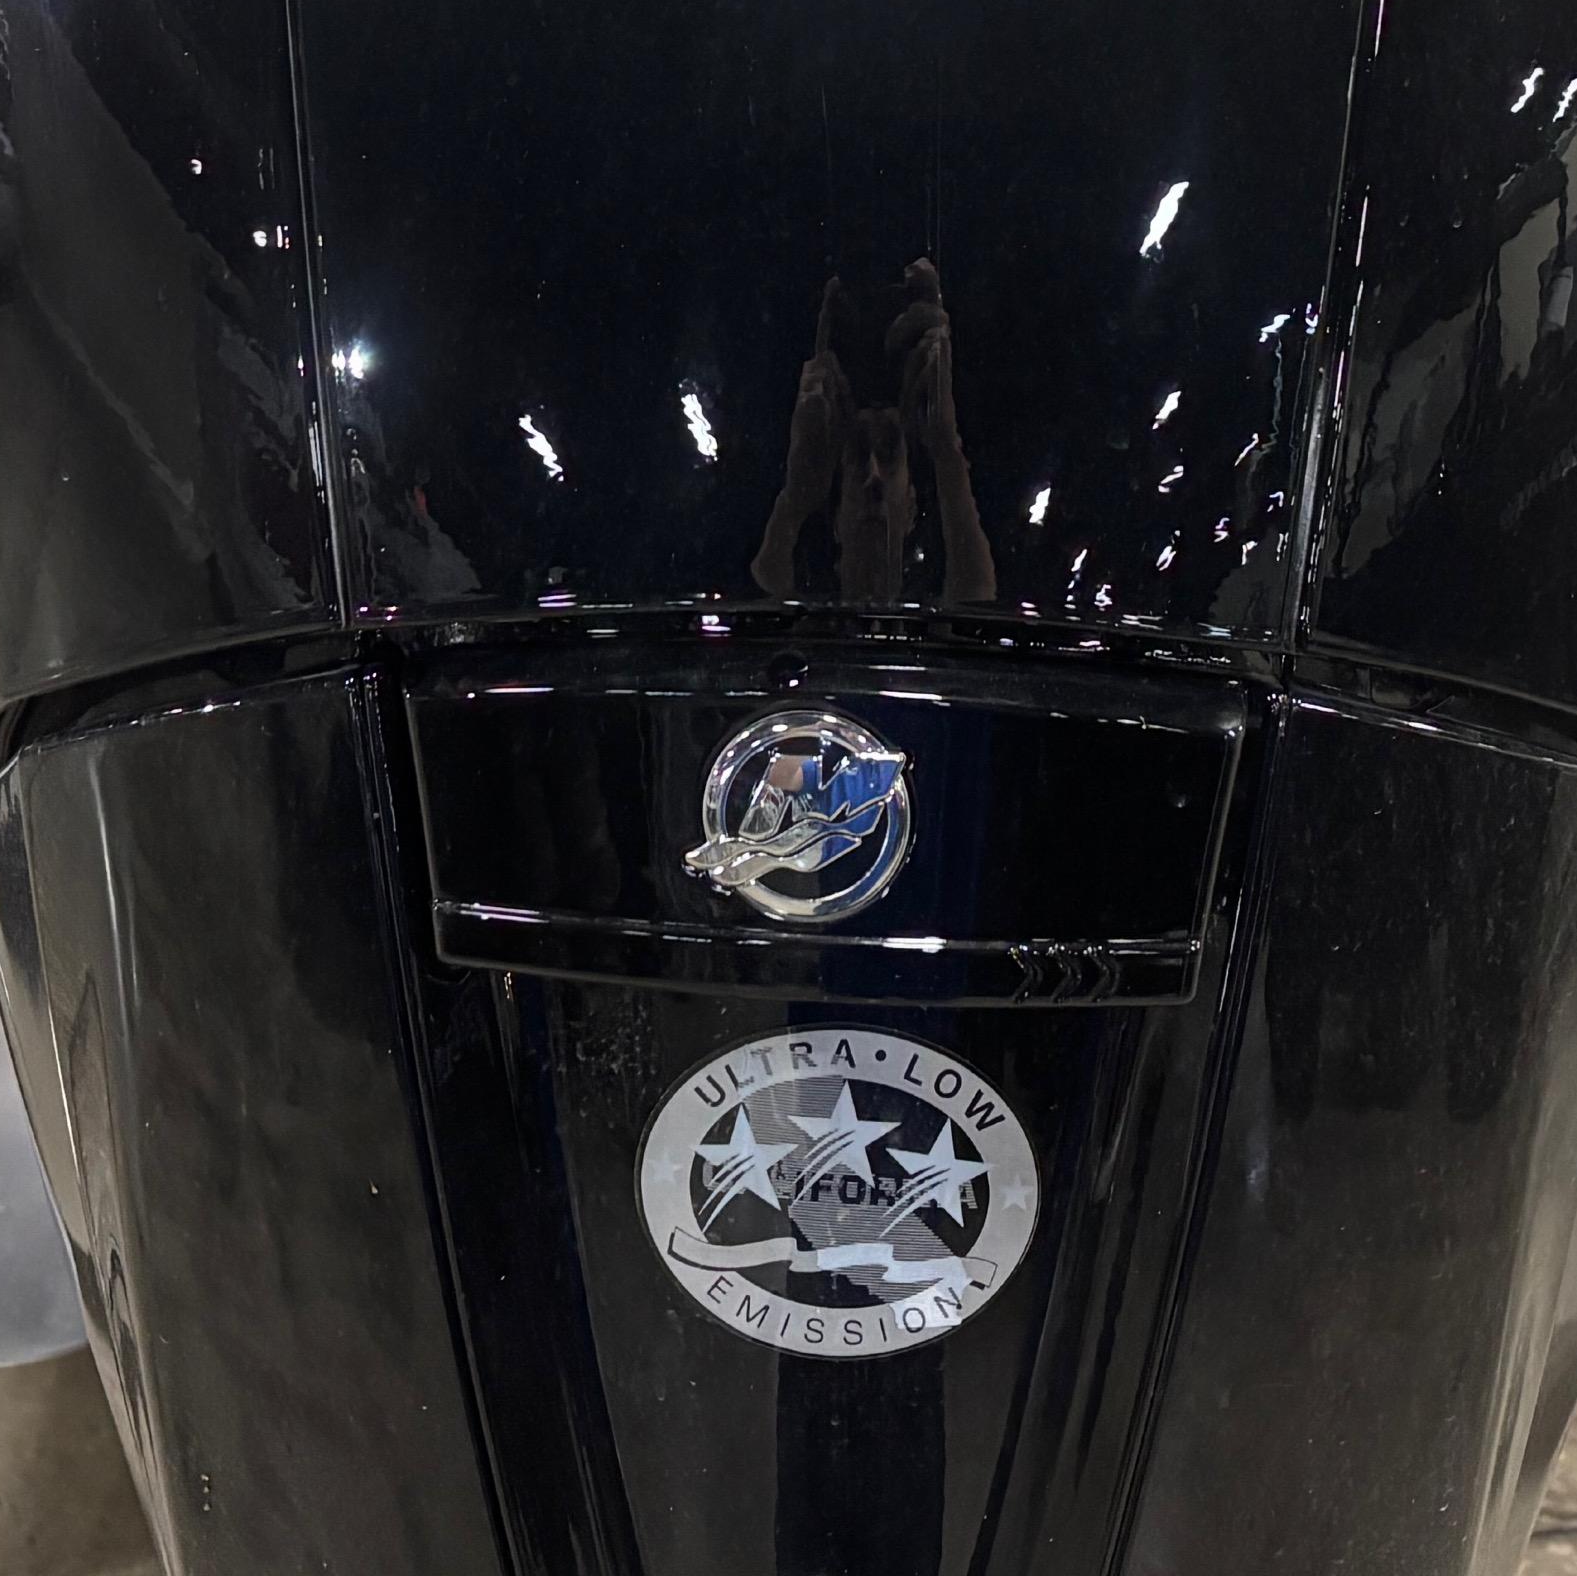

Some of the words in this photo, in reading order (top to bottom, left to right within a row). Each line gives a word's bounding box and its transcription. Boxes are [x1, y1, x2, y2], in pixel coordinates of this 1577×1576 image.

[693, 1038, 857, 1108] ULTRA
[903, 1053, 1006, 1133] LOW
[706, 1274, 964, 1346] EMISSION
